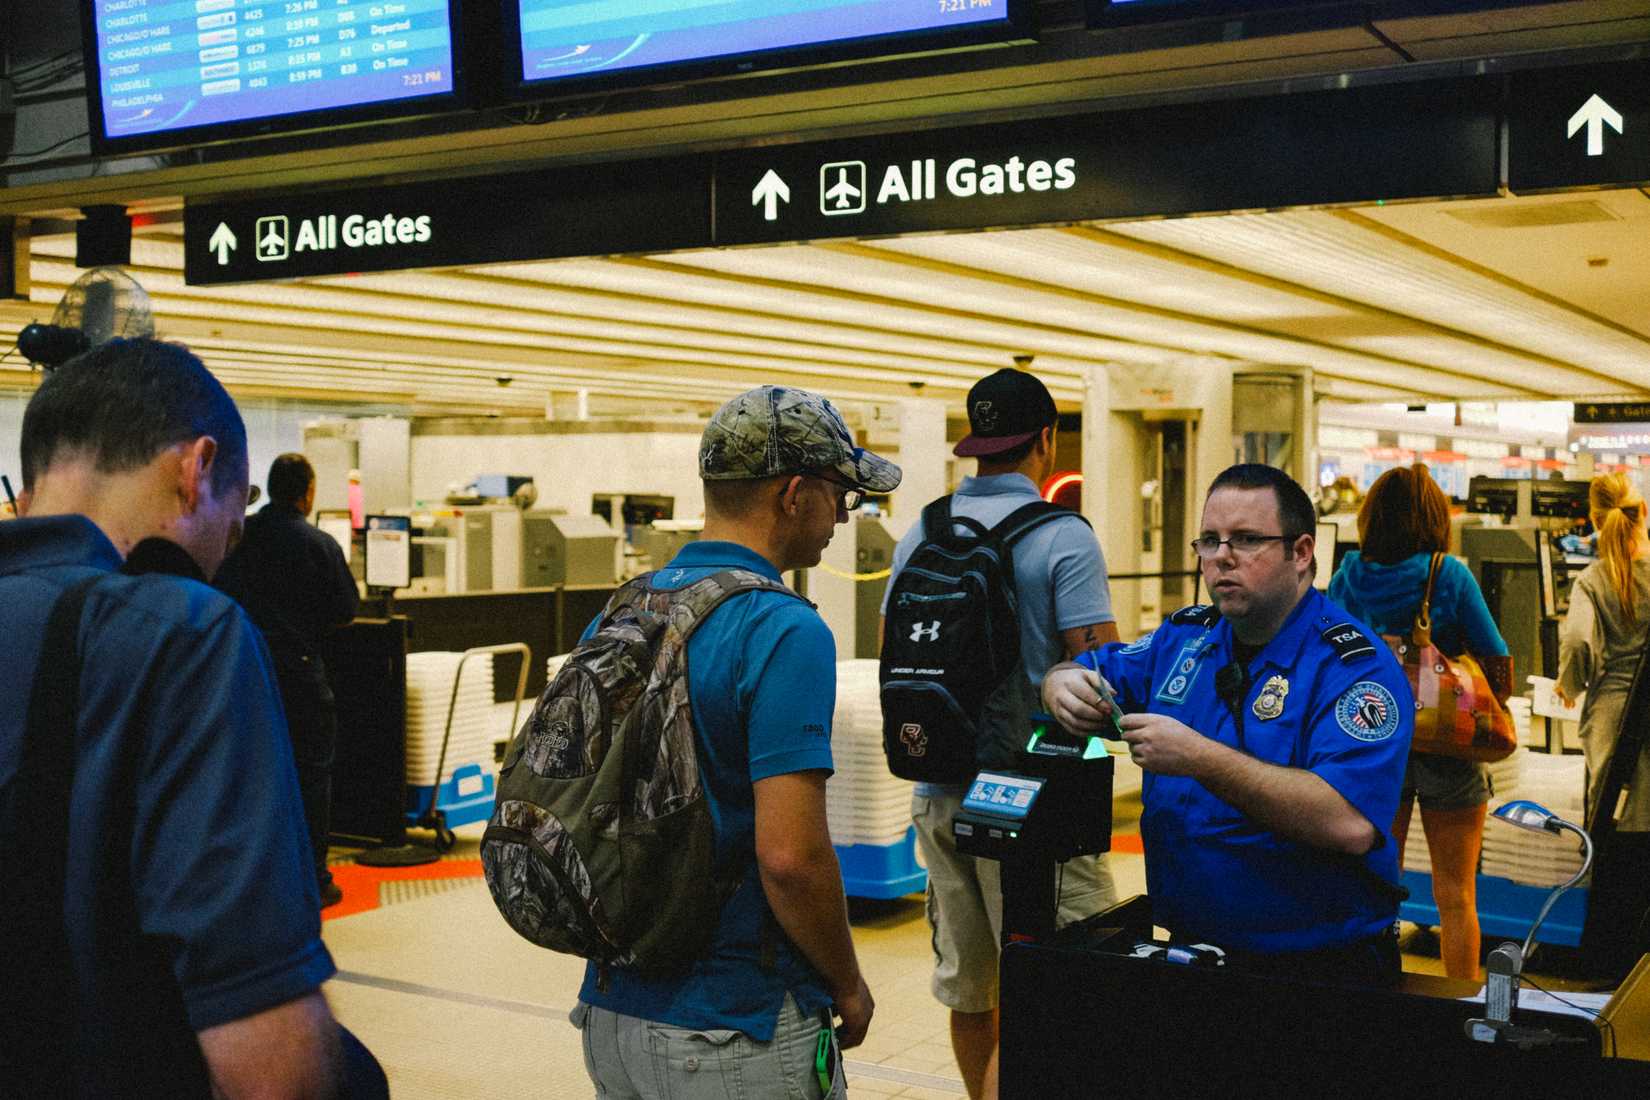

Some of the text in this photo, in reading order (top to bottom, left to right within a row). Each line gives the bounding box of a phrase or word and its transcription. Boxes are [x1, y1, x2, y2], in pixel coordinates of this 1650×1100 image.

[938, 0, 966, 15] 7:21
[402, 70, 441, 86] 7:21 PM
[877, 155, 1076, 203] All Gates
[295, 214, 431, 252] All Gates
[1331, 630, 1363, 644] TSA
